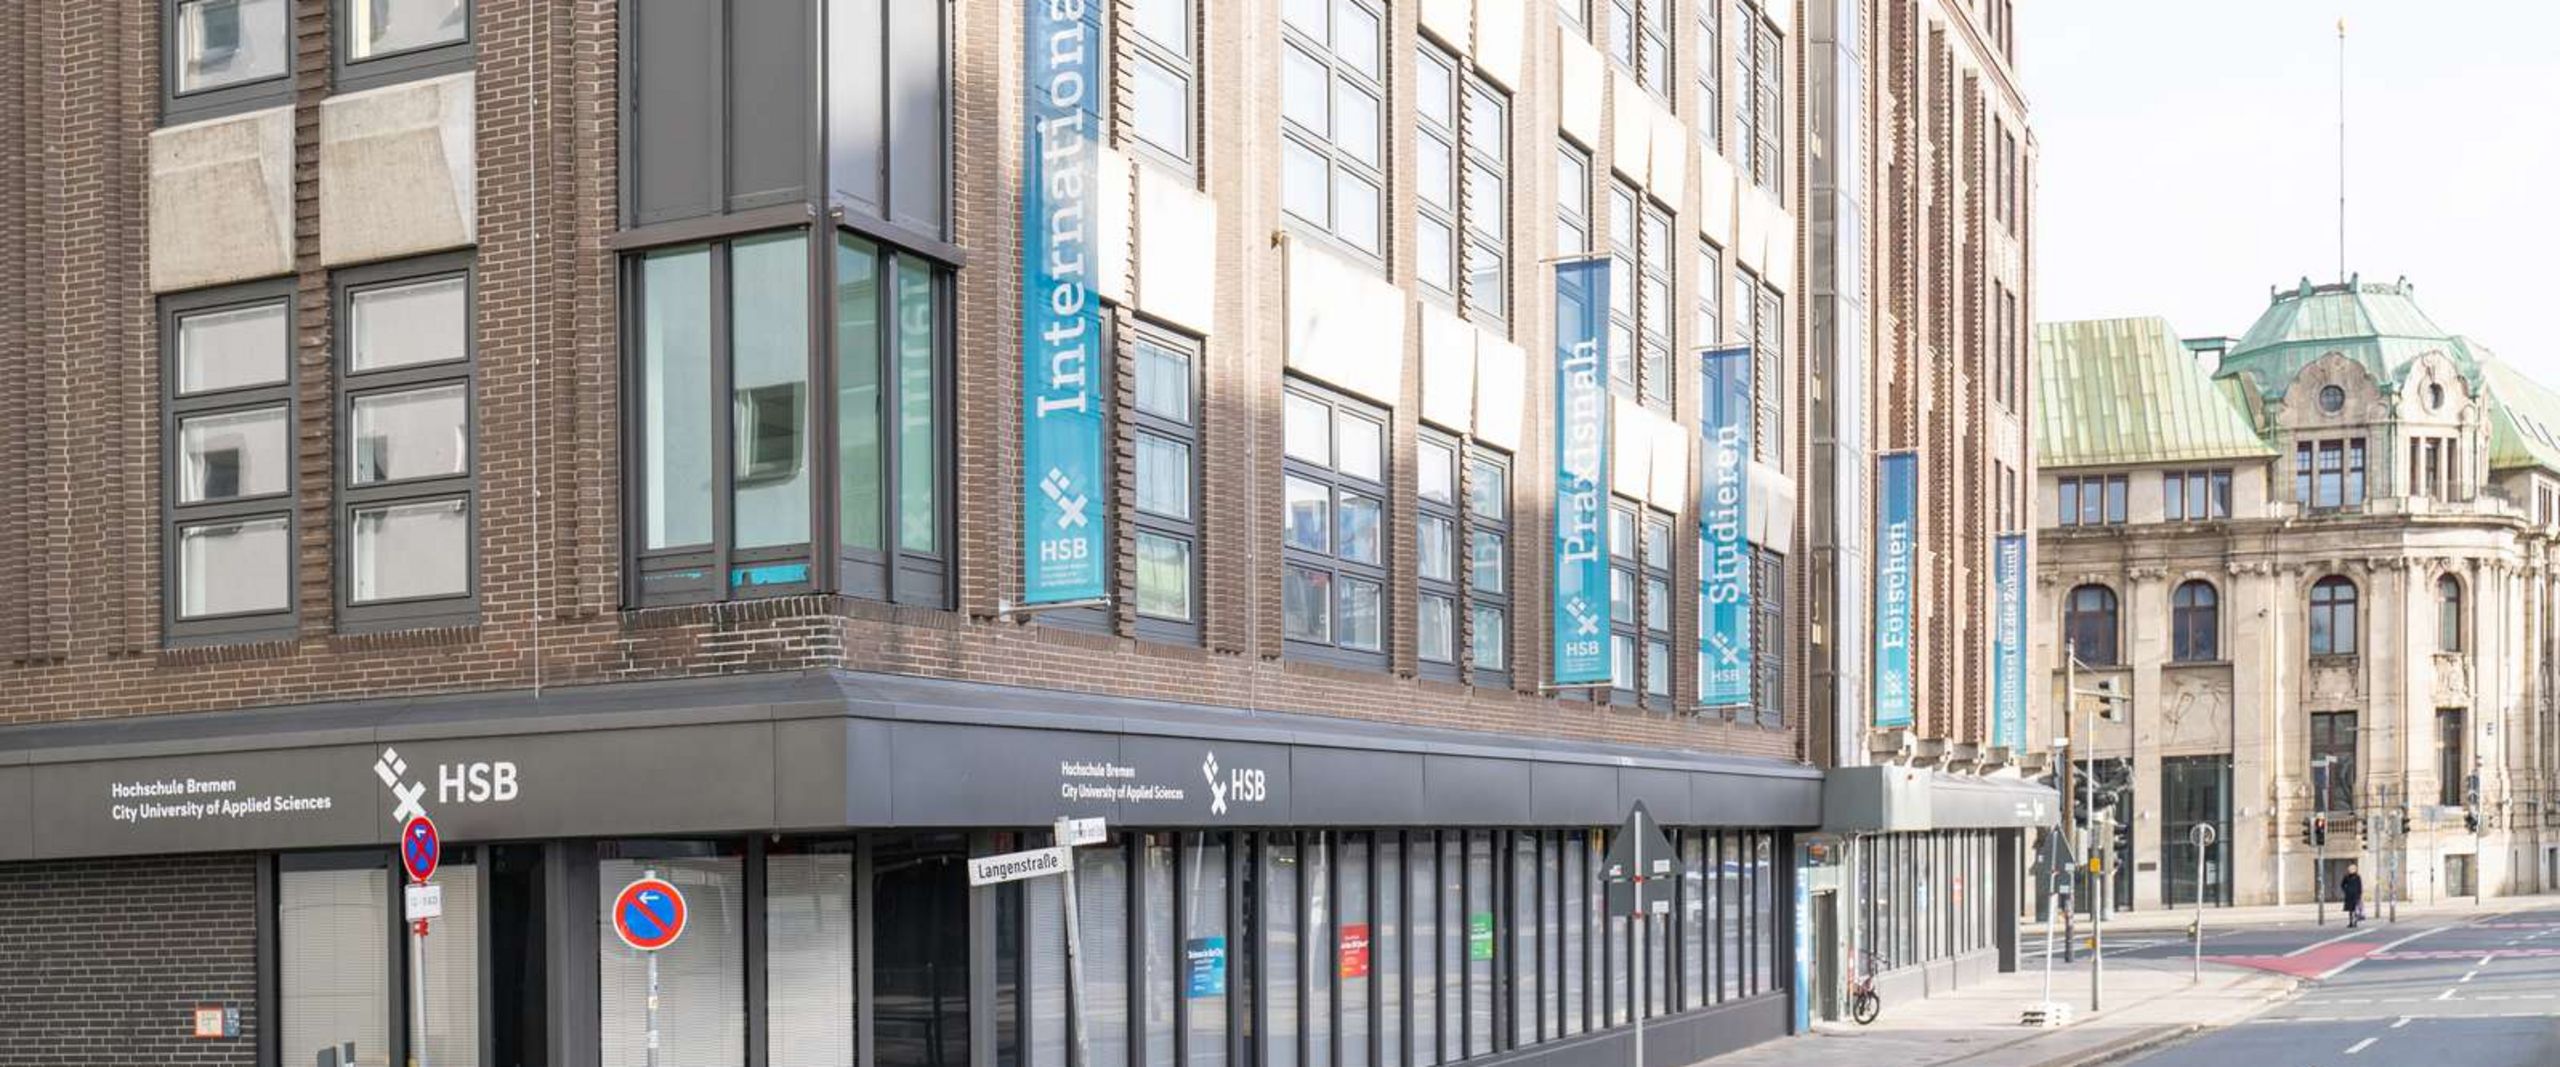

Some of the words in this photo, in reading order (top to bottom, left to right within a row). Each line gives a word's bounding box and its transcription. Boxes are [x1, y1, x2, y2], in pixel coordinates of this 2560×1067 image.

[1564, 338, 1597, 564] Praxisnah
[1709, 422, 1739, 604] Studieren
[1041, 537, 1087, 562] HSB
[1882, 520, 1906, 649] Forschen
[1566, 640, 1599, 657] HSB
[439, 762, 519, 803] HSB
[1062, 762, 1105, 778] Hochschule
[1106, 763, 1136, 778] Bremen
[111, 779, 184, 798] Hochschule
[187, 778, 236, 794] Bremen
[1062, 783, 1077, 802] City
[1078, 784, 1116, 802] University
[1117, 784, 1126, 799] of
[1127, 785, 1153, 803] Applied
[1154, 785, 1184, 799] Sciences
[1232, 768, 1266, 801] HSB
[112, 804, 137, 822] City
[140, 800, 203, 819] University
[206, 800, 220, 815] of
[222, 797, 271, 818] Applied
[274, 795, 332, 811] Sciences
[978, 852, 1058, 879] Langenstraße
